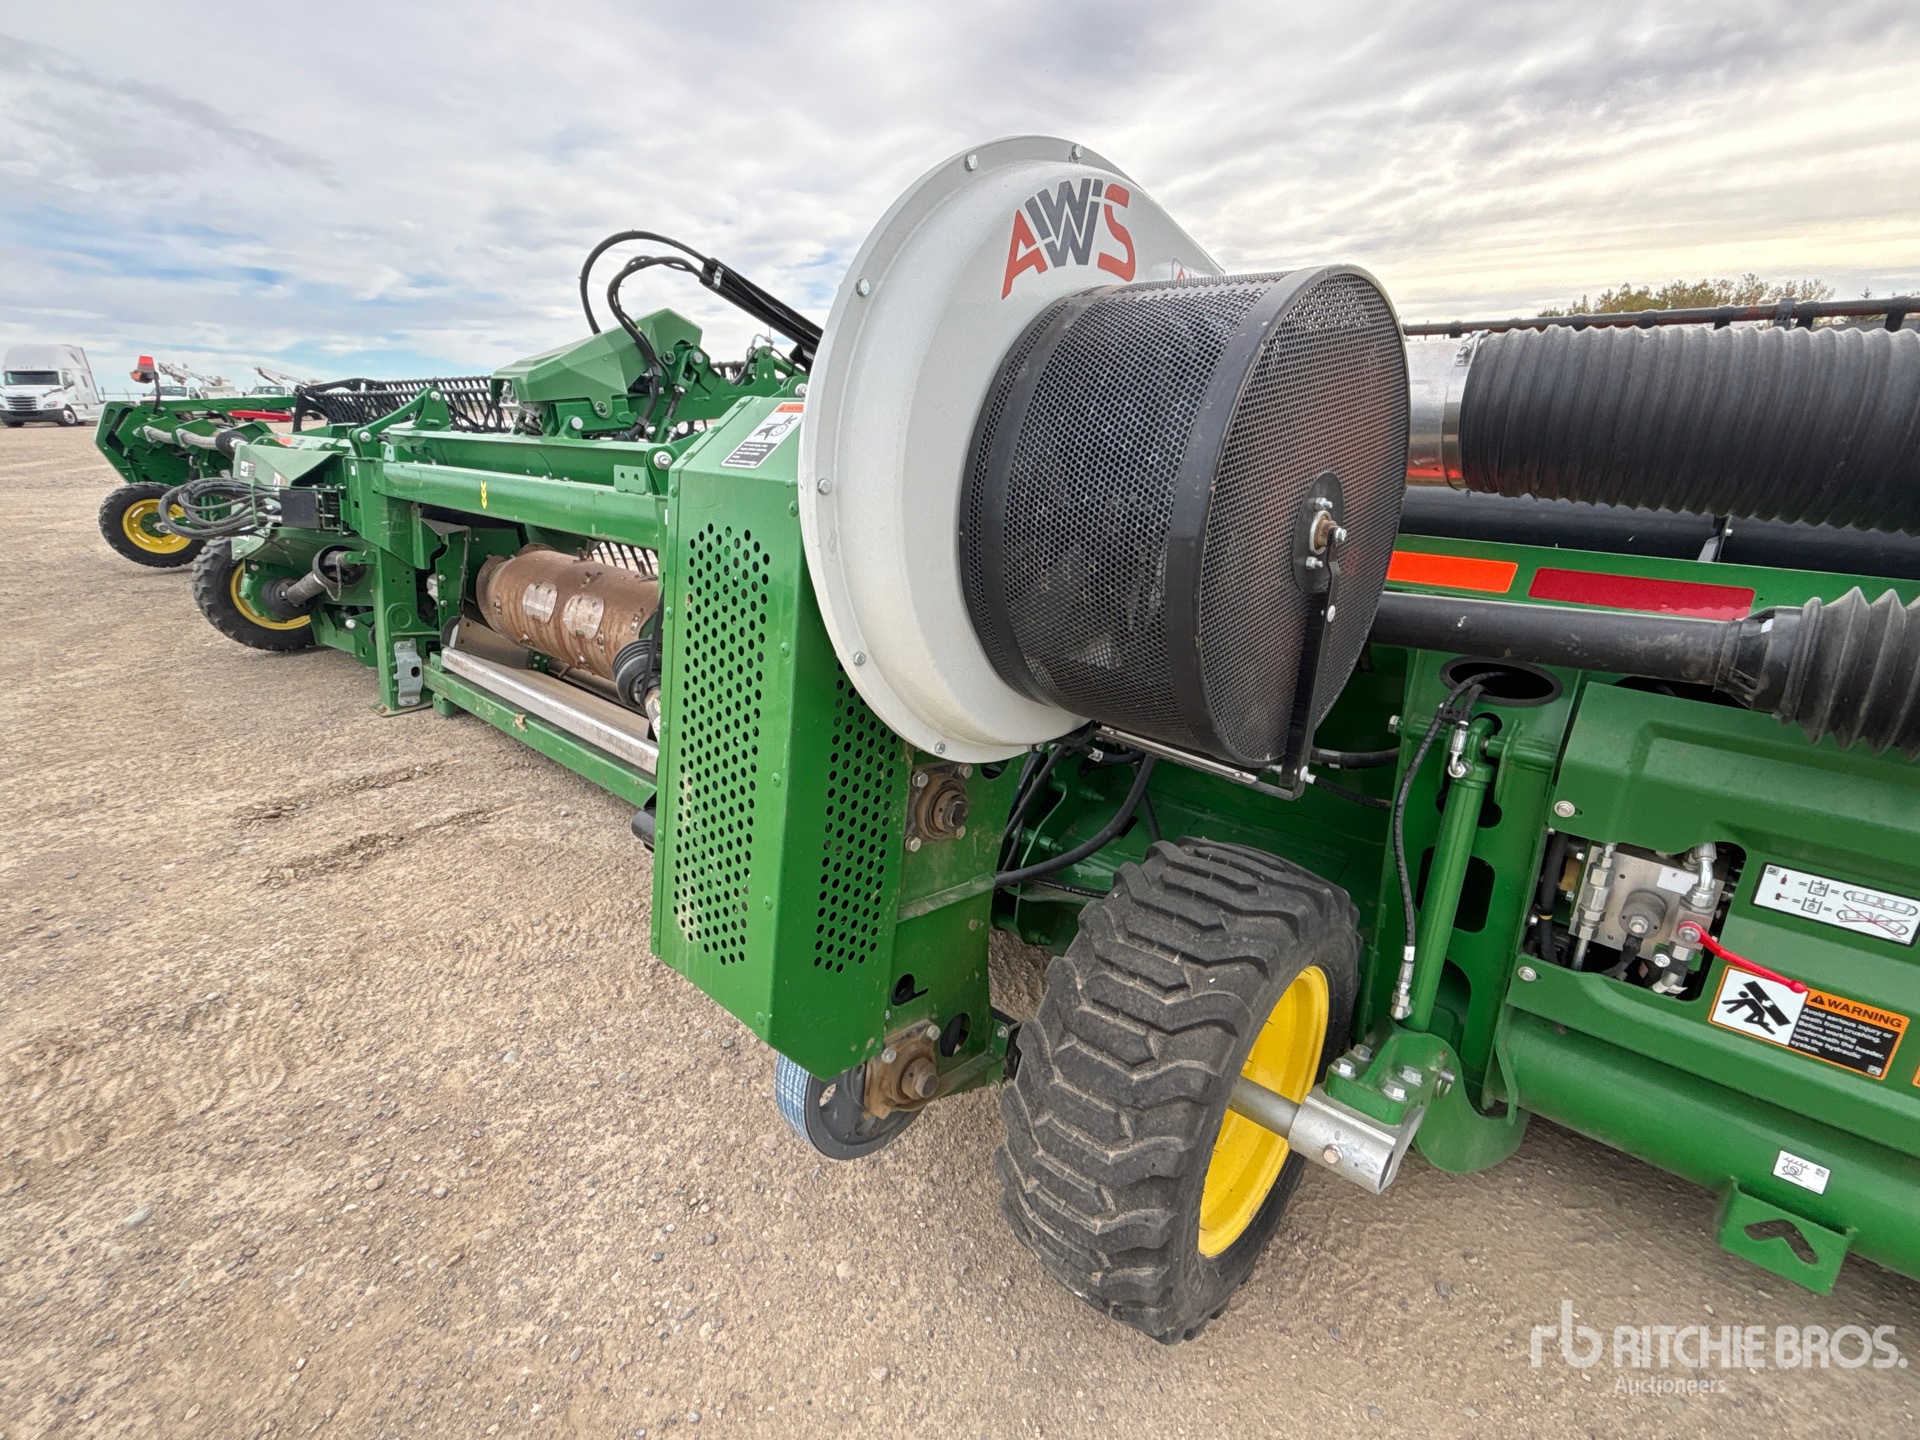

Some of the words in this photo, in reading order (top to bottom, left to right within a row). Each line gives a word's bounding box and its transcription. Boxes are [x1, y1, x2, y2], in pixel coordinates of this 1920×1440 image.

[1002, 178, 1136, 300] AWS
[1803, 1007, 1826, 1018] Avoid
[1827, 1014, 1857, 1028] serious
[1858, 1024, 1882, 1036] injury
[1828, 998, 1903, 1028] WARNING
[1796, 1028, 1840, 1045] underneath
[1841, 1040, 1854, 1049] the
[1799, 1020, 1824, 1033] Before
[1825, 1029, 1857, 1043] working
[1800, 1014, 1823, 1025] death
[1824, 1021, 1842, 1031] from
[1844, 1028, 1881, 1043] crushing.
[1790, 1040, 1820, 1054] system.
[1794, 1034, 1809, 1043] lock
[1811, 1038, 1824, 1047] the
[1825, 1043, 1862, 1060] hydraulic
